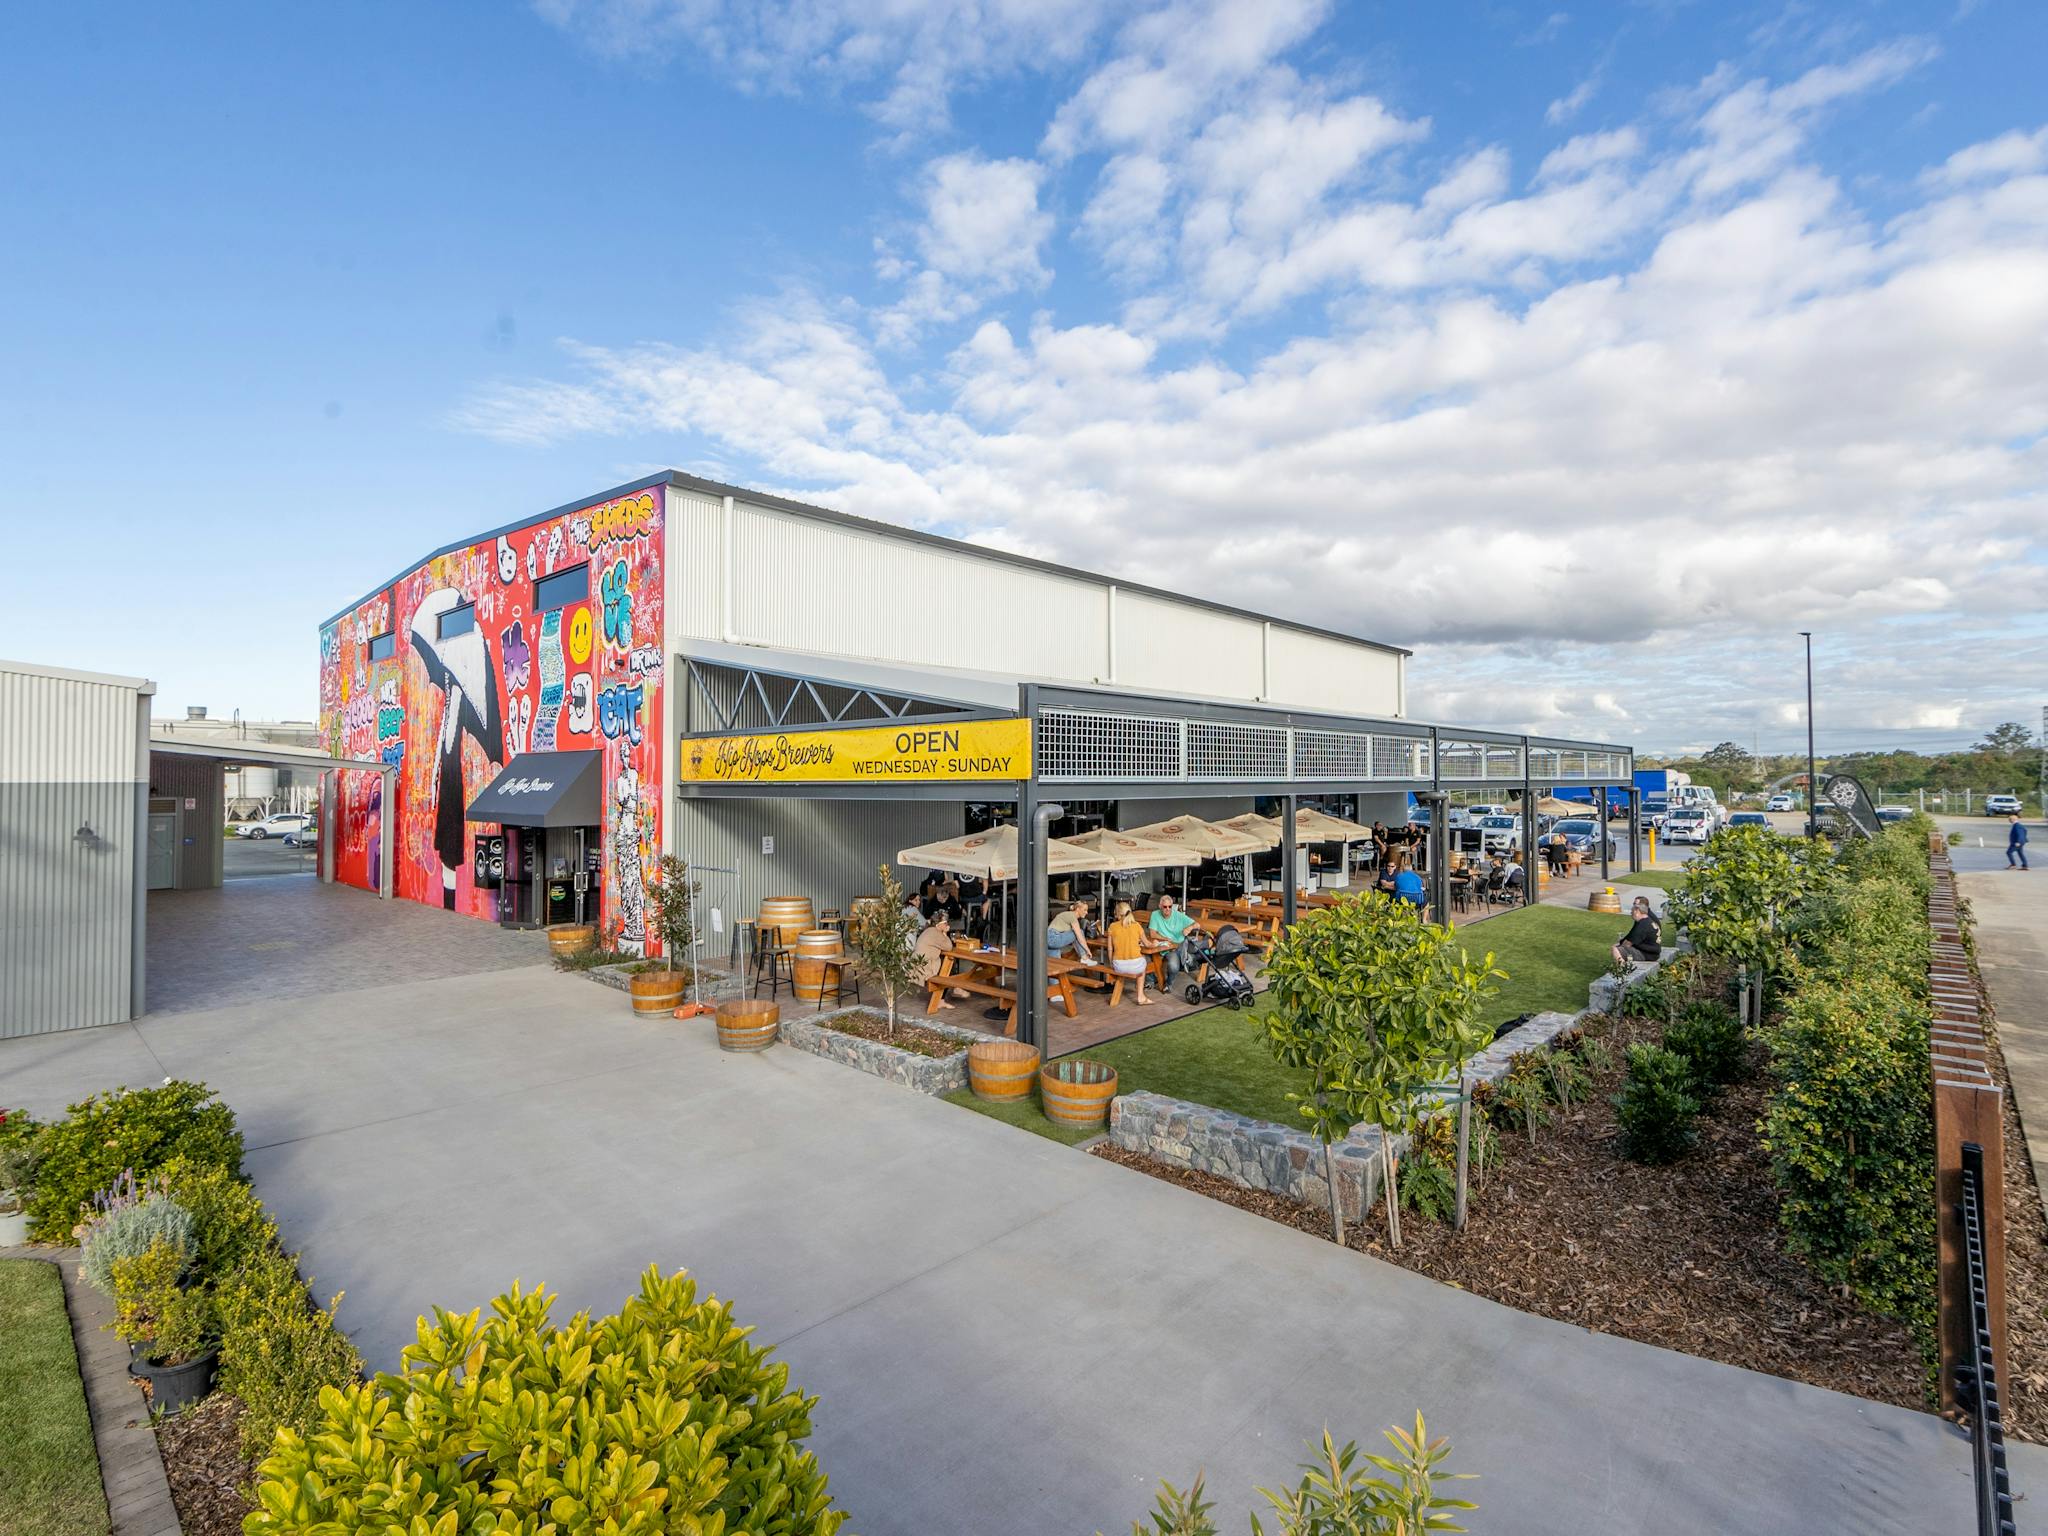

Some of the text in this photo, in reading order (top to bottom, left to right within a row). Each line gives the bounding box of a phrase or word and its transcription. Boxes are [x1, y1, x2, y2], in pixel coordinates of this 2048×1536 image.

[464, 551, 490, 586] LOVE
[896, 730, 960, 754] OPEN
[714, 735, 835, 780] Hip Hops Brewers
[852, 759, 938, 775] WEDNESDAY
[948, 757, 1012, 773] SUNDAY
